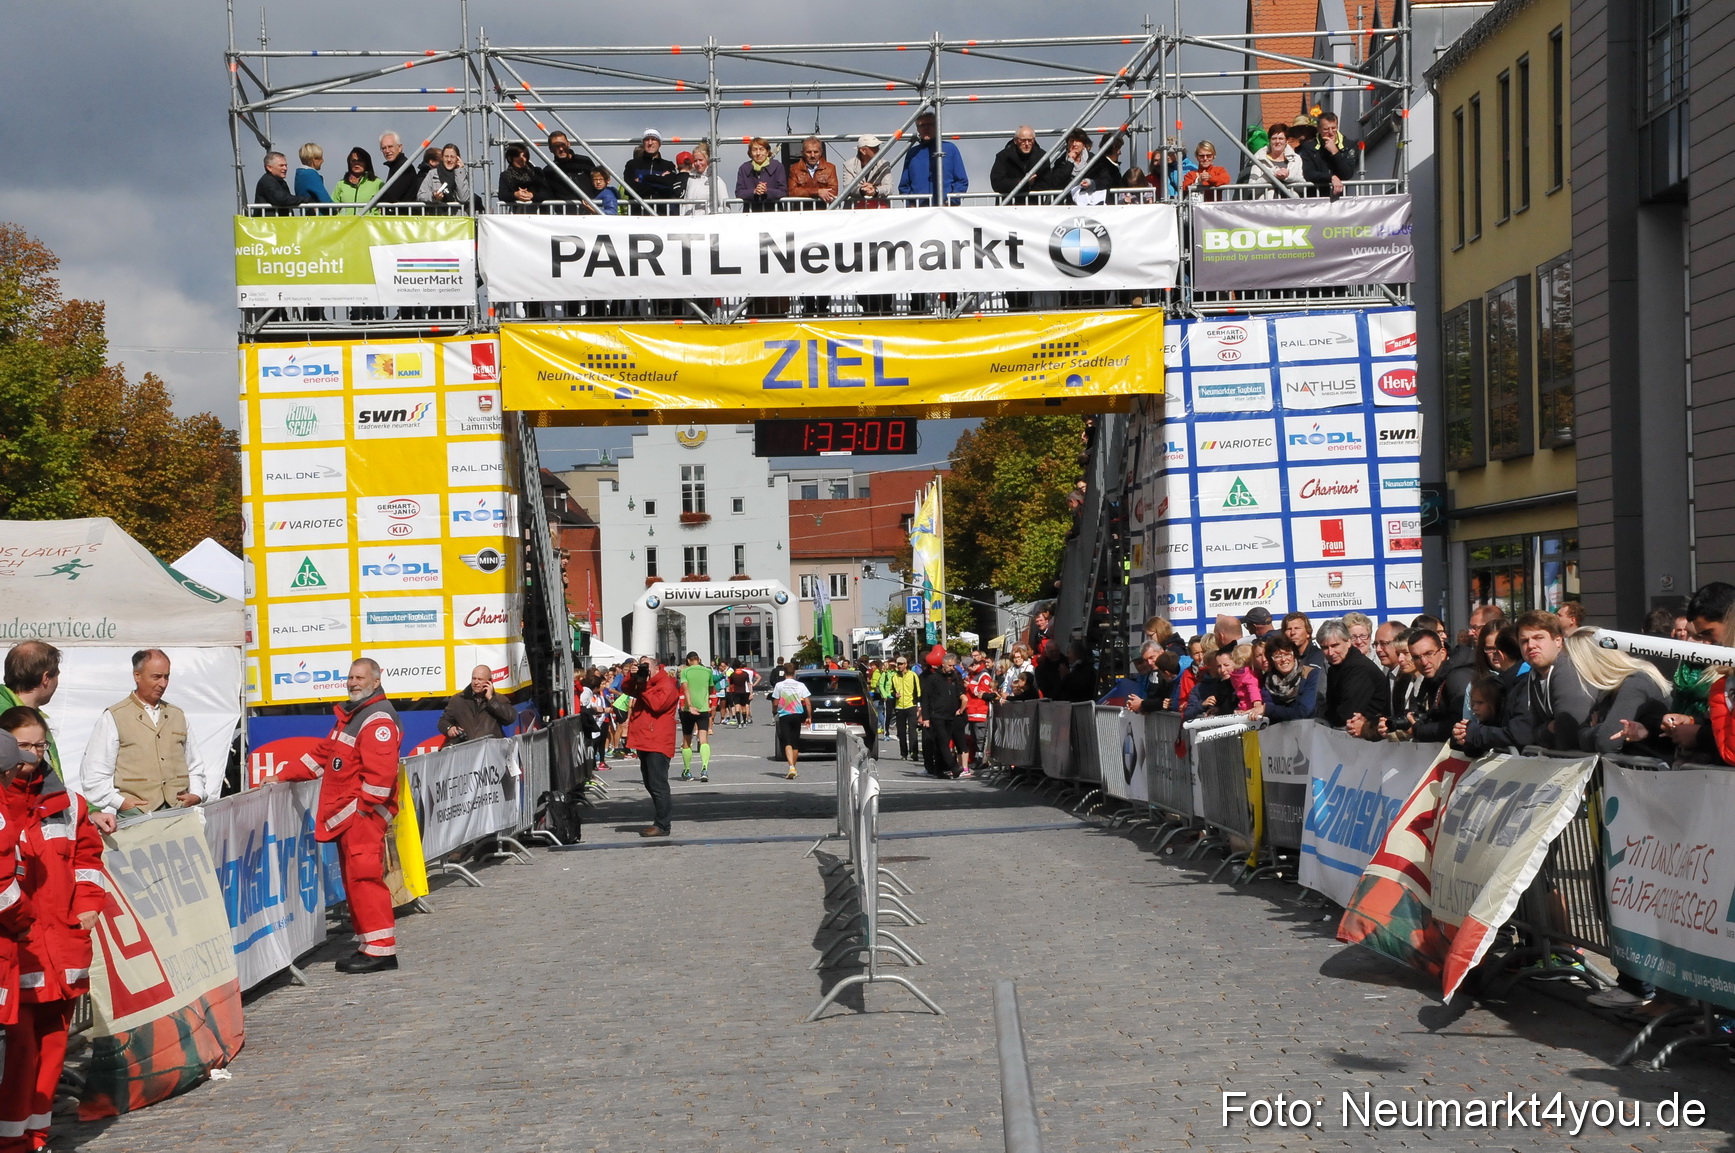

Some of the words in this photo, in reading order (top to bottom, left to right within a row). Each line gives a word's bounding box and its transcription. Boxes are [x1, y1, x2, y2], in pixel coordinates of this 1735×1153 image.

[1053, 217, 1107, 238] BMW
[1322, 225, 1371, 239] OFFICE
[1205, 228, 1311, 250] BOCK
[271, 243, 301, 255] wo's
[550, 232, 742, 278] PARTL
[759, 229, 1025, 275] Neumarkt
[1203, 253, 1236, 262] inspired
[1238, 253, 1248, 262] by
[1251, 251, 1276, 260] smart
[1278, 251, 1315, 261] concepts
[257, 258, 344, 278] langgeht!
[393, 275, 463, 285] NeuerMarkt
[1207, 329, 1241, 337] GERHART
[1280, 338, 1333, 348] RAIL.ONE
[472, 364, 494, 374] Braun
[761, 338, 910, 391] ZIEL
[990, 358, 1067, 374] Neumarkter
[1070, 355, 1130, 369] Stadtlauf
[303, 375, 340, 384] energie
[537, 368, 613, 384] Neumarkter
[617, 368, 678, 384] Stadtlauf
[1201, 387, 1236, 396] Neumarkter
[1237, 386, 1263, 394] Tagblatt
[1286, 379, 1356, 394] NATHUS
[287, 403, 315, 420] RUND
[358, 409, 407, 424] swn
[287, 418, 319, 436] SCHAU
[803, 421, 906, 452] 1:33:08
[1379, 428, 1416, 441] swn
[1219, 438, 1273, 450] VARIOTEC
[1327, 443, 1362, 451] energie
[266, 472, 321, 481] RAIL.ONE
[1299, 478, 1360, 500] Charivari
[377, 503, 412, 512] GERHART
[289, 518, 343, 530] VARIOTEC
[391, 526, 409, 534] KIA
[1205, 542, 1258, 552] RAIL.ONE
[1321, 540, 1343, 551] Braun
[479, 556, 498, 565] MINI
[402, 573, 439, 582] energie
[704, 586, 770, 600] Laufsport
[1209, 586, 1257, 601] swn
[1318, 591, 1355, 599] Neumarkter
[910, 598, 919, 611] P
[1311, 597, 1362, 608] Lammsbräu
[370, 614, 406, 622] Neumarkter
[408, 613, 434, 622] Tagblatt
[272, 623, 326, 634] RAIL.ONE
[386, 665, 442, 677] VARIOTEC
